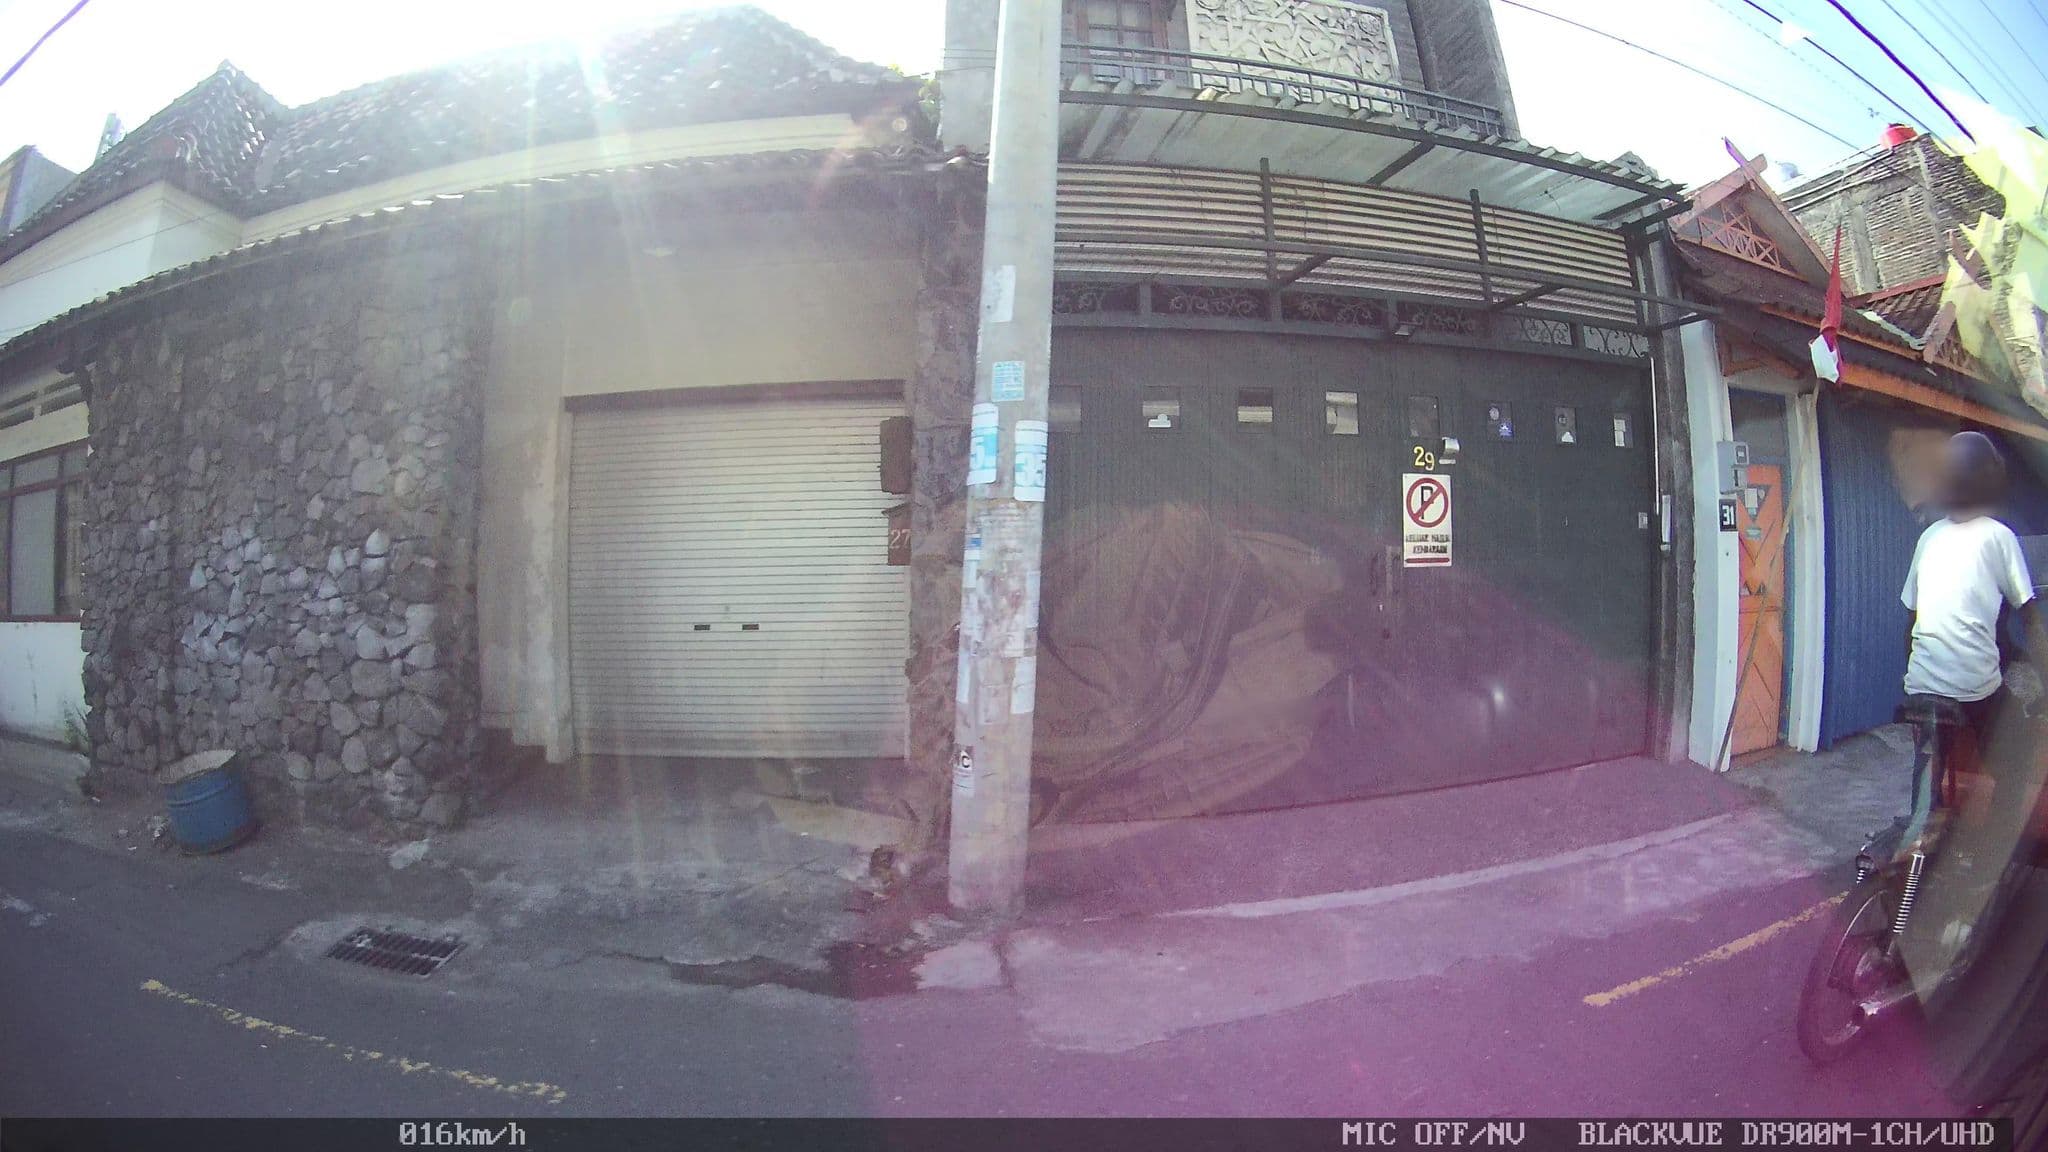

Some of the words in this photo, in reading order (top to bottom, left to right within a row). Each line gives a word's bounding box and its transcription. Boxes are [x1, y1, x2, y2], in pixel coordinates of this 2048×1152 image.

[1413, 446, 1435, 471] 29
[1722, 505, 1735, 526] 31
[889, 528, 911, 550] 27
